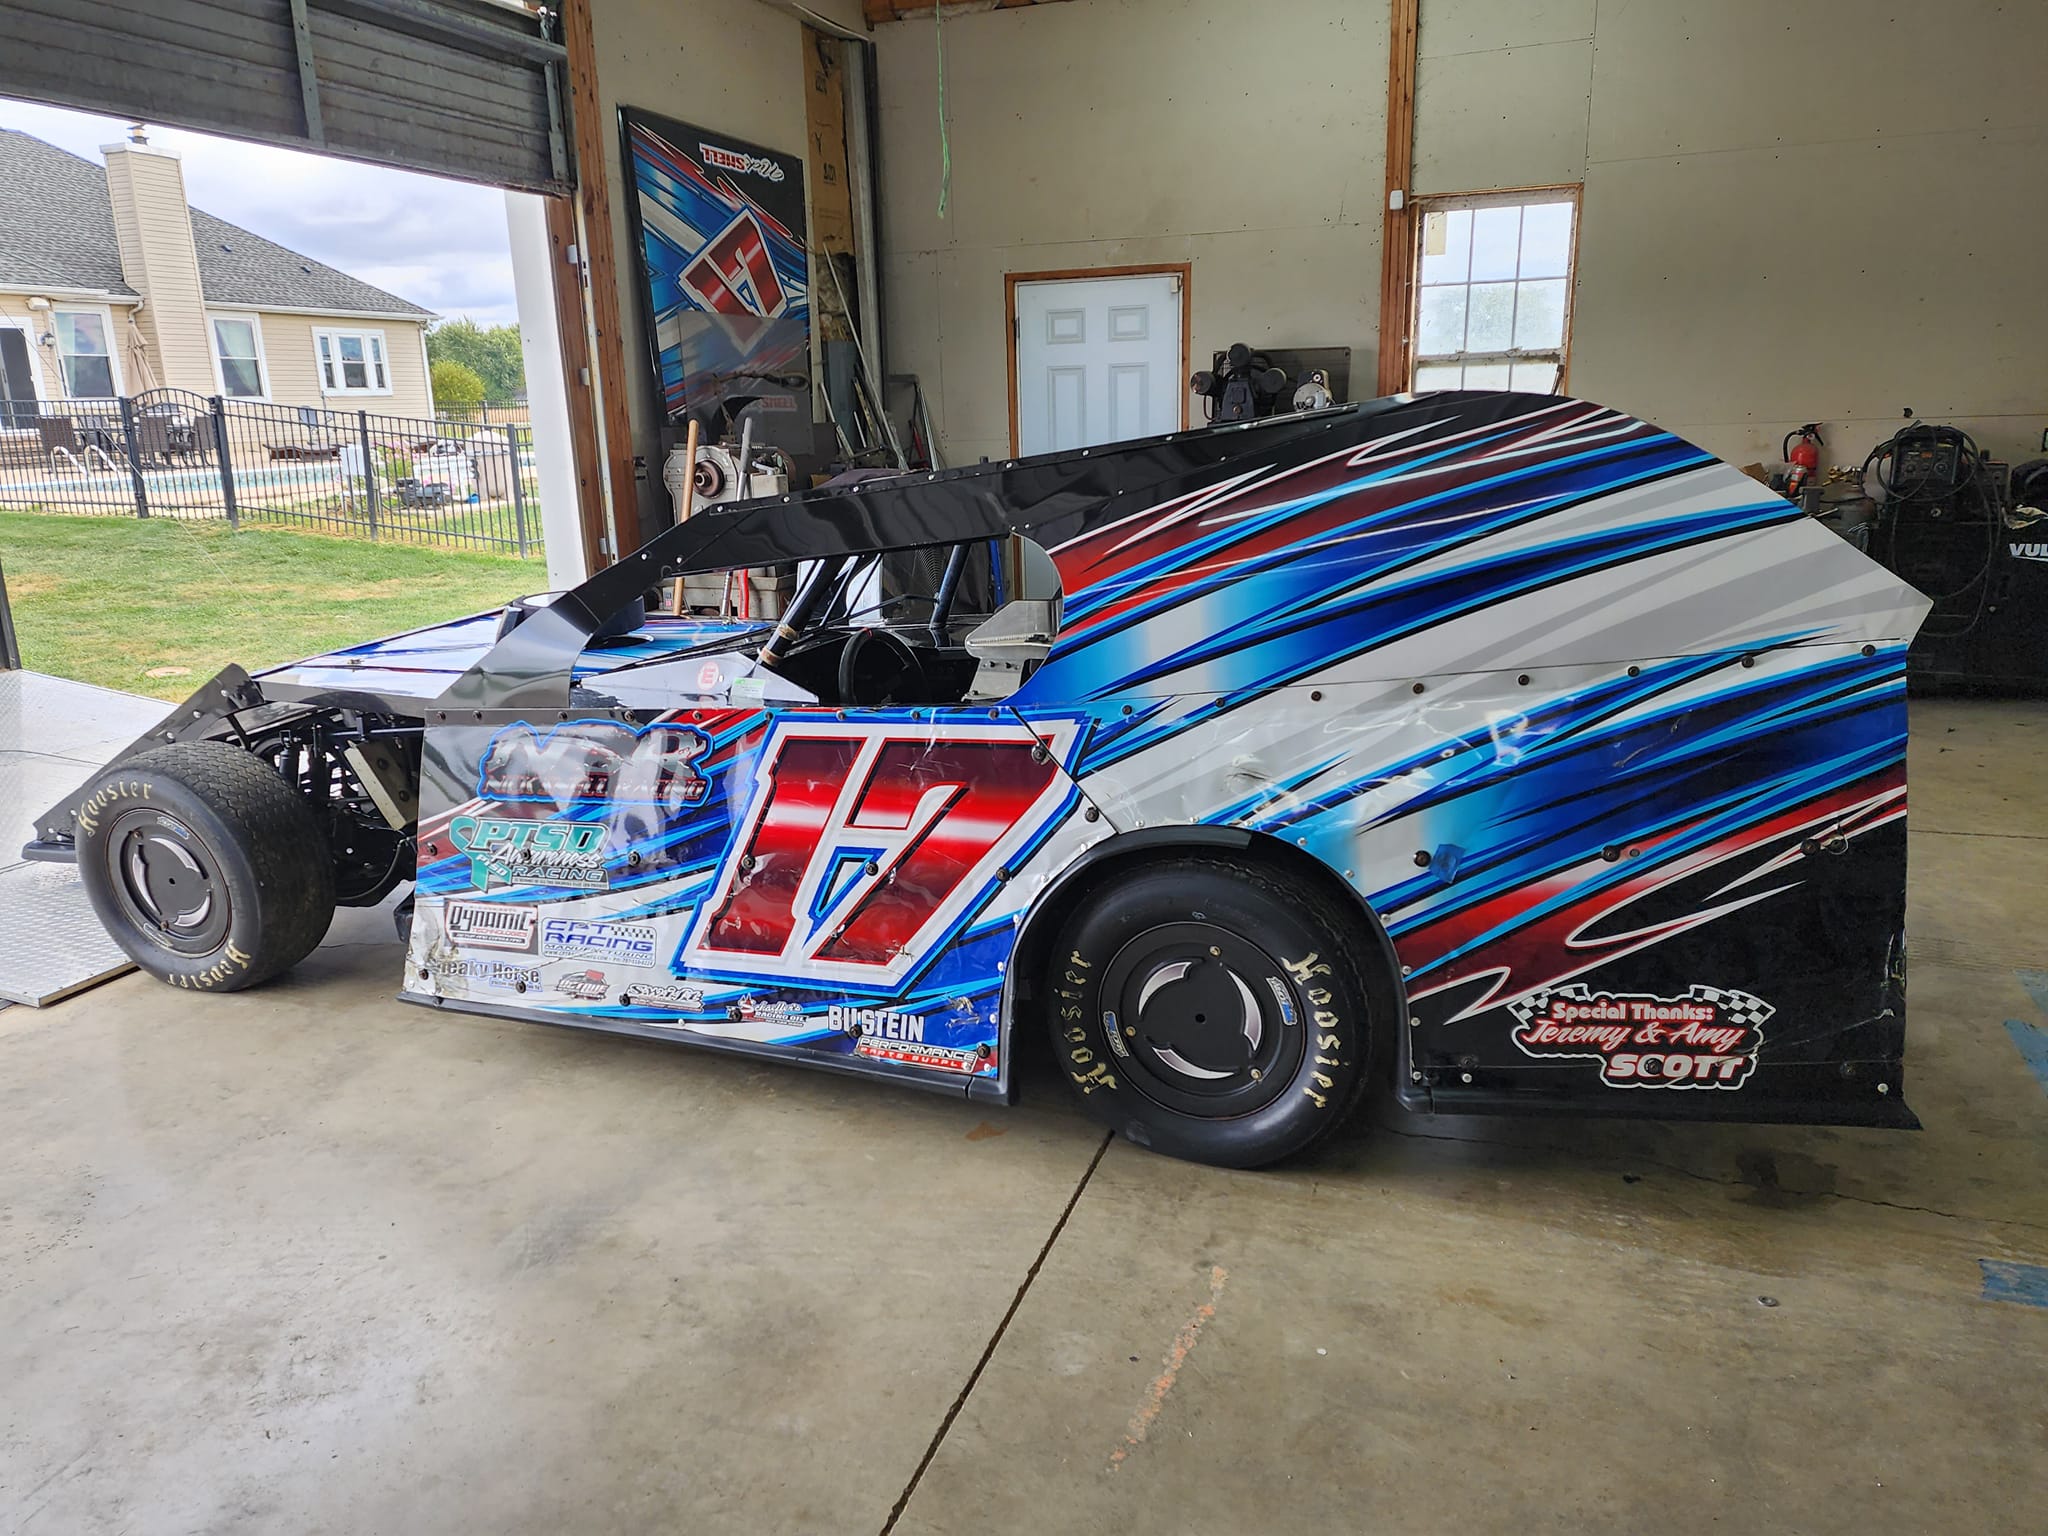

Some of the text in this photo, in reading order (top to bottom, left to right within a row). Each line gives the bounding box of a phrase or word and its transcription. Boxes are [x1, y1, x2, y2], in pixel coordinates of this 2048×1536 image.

[699, 143, 748, 173] SHELL
[77, 781, 152, 837] Hoosier
[472, 820, 607, 853] PTSD
[686, 714, 1076, 986] 17
[513, 866, 604, 881] RACING
[545, 920, 611, 935] CPT
[545, 932, 653, 952] RACING
[492, 964, 540, 983] Horse
[1552, 1000, 1714, 1023] Special Thanks:
[1281, 952, 1350, 1109] Hoosier
[1522, 1019, 1746, 1053] Jeremy & Amy
[859, 1037, 977, 1062] PERFORMANCE
[860, 1046, 905, 1060] PARTS
[1607, 1054, 1745, 1079] SCOTT
